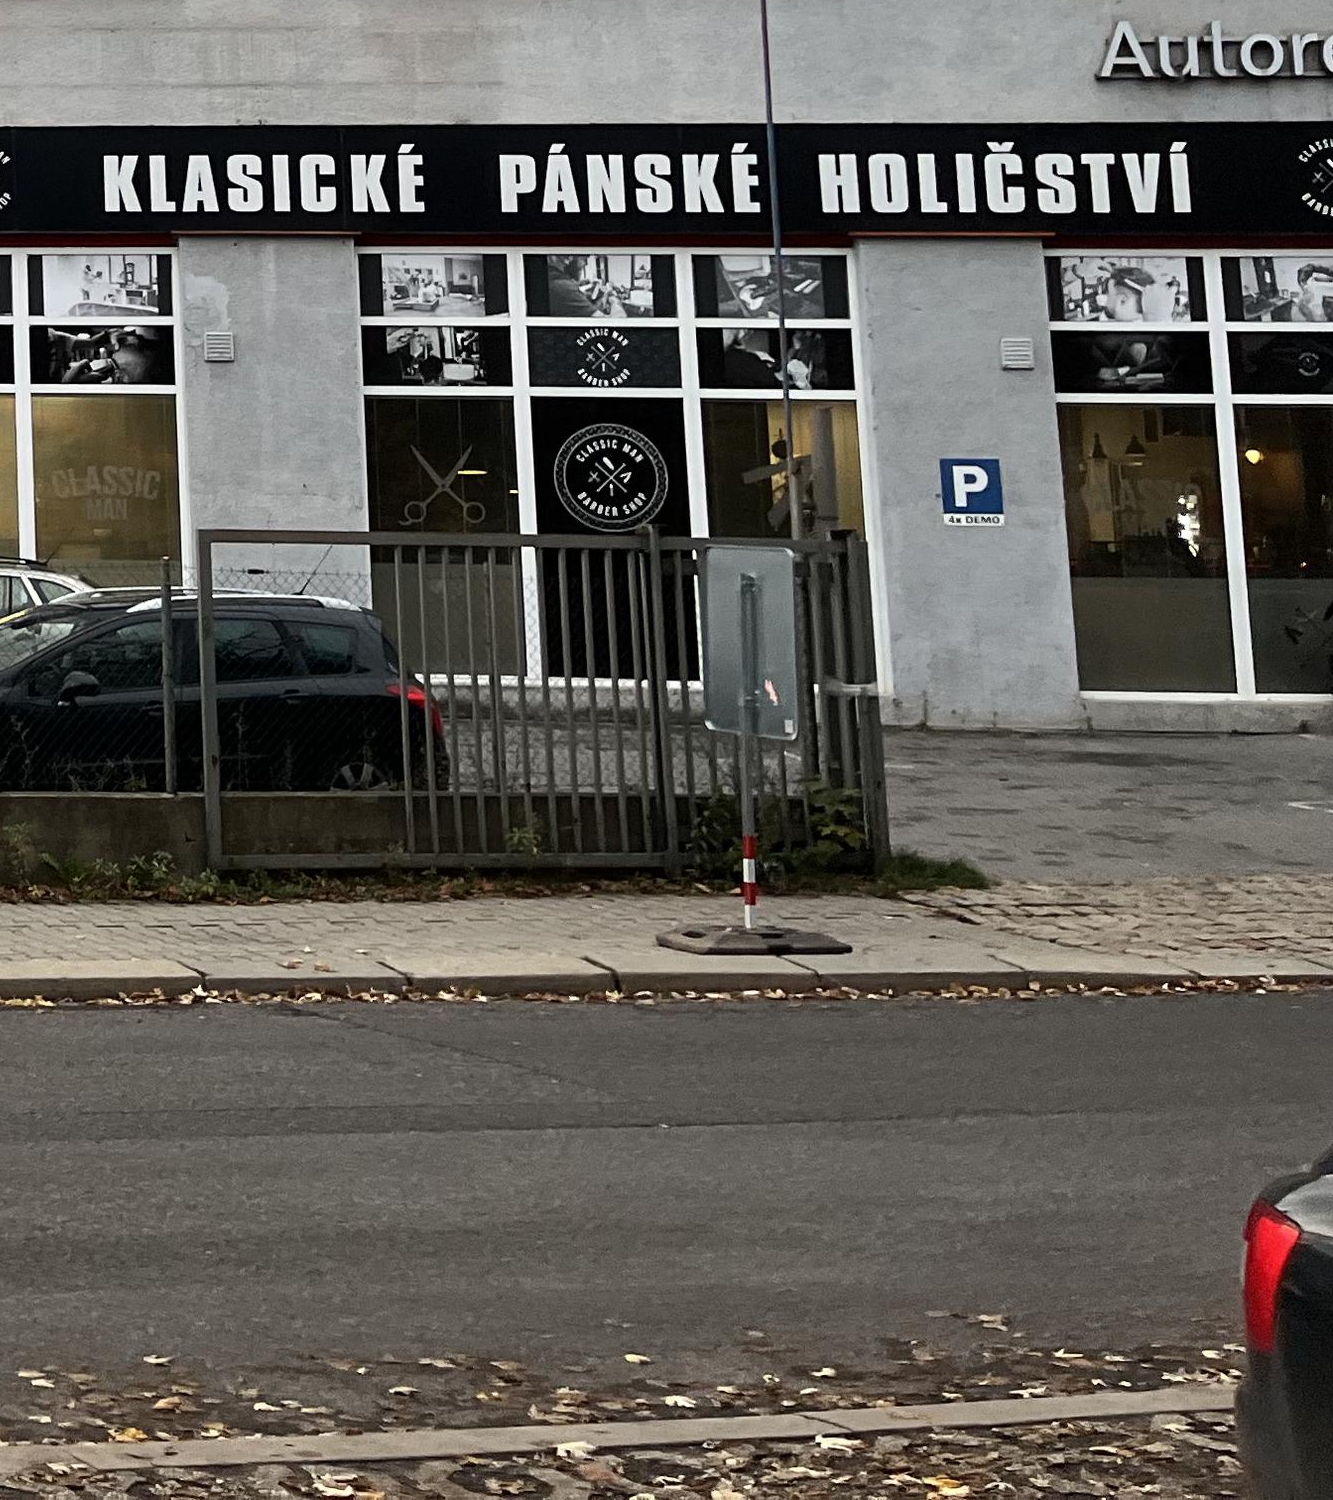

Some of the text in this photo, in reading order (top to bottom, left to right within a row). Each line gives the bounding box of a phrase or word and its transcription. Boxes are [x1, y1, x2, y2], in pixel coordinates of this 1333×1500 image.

[1101, 20, 1333, 77] Autor
[103, 141, 1192, 214] KLASICKÉ PÁNSKÉ HOLIČSTVÍ
[576, 439, 644, 463] CLASSIC MAN
[53, 465, 162, 500] CLASSIC
[952, 465, 989, 508] P
[577, 492, 647, 517] BARBER SHOP
[965, 515, 1000, 524] DEMO
